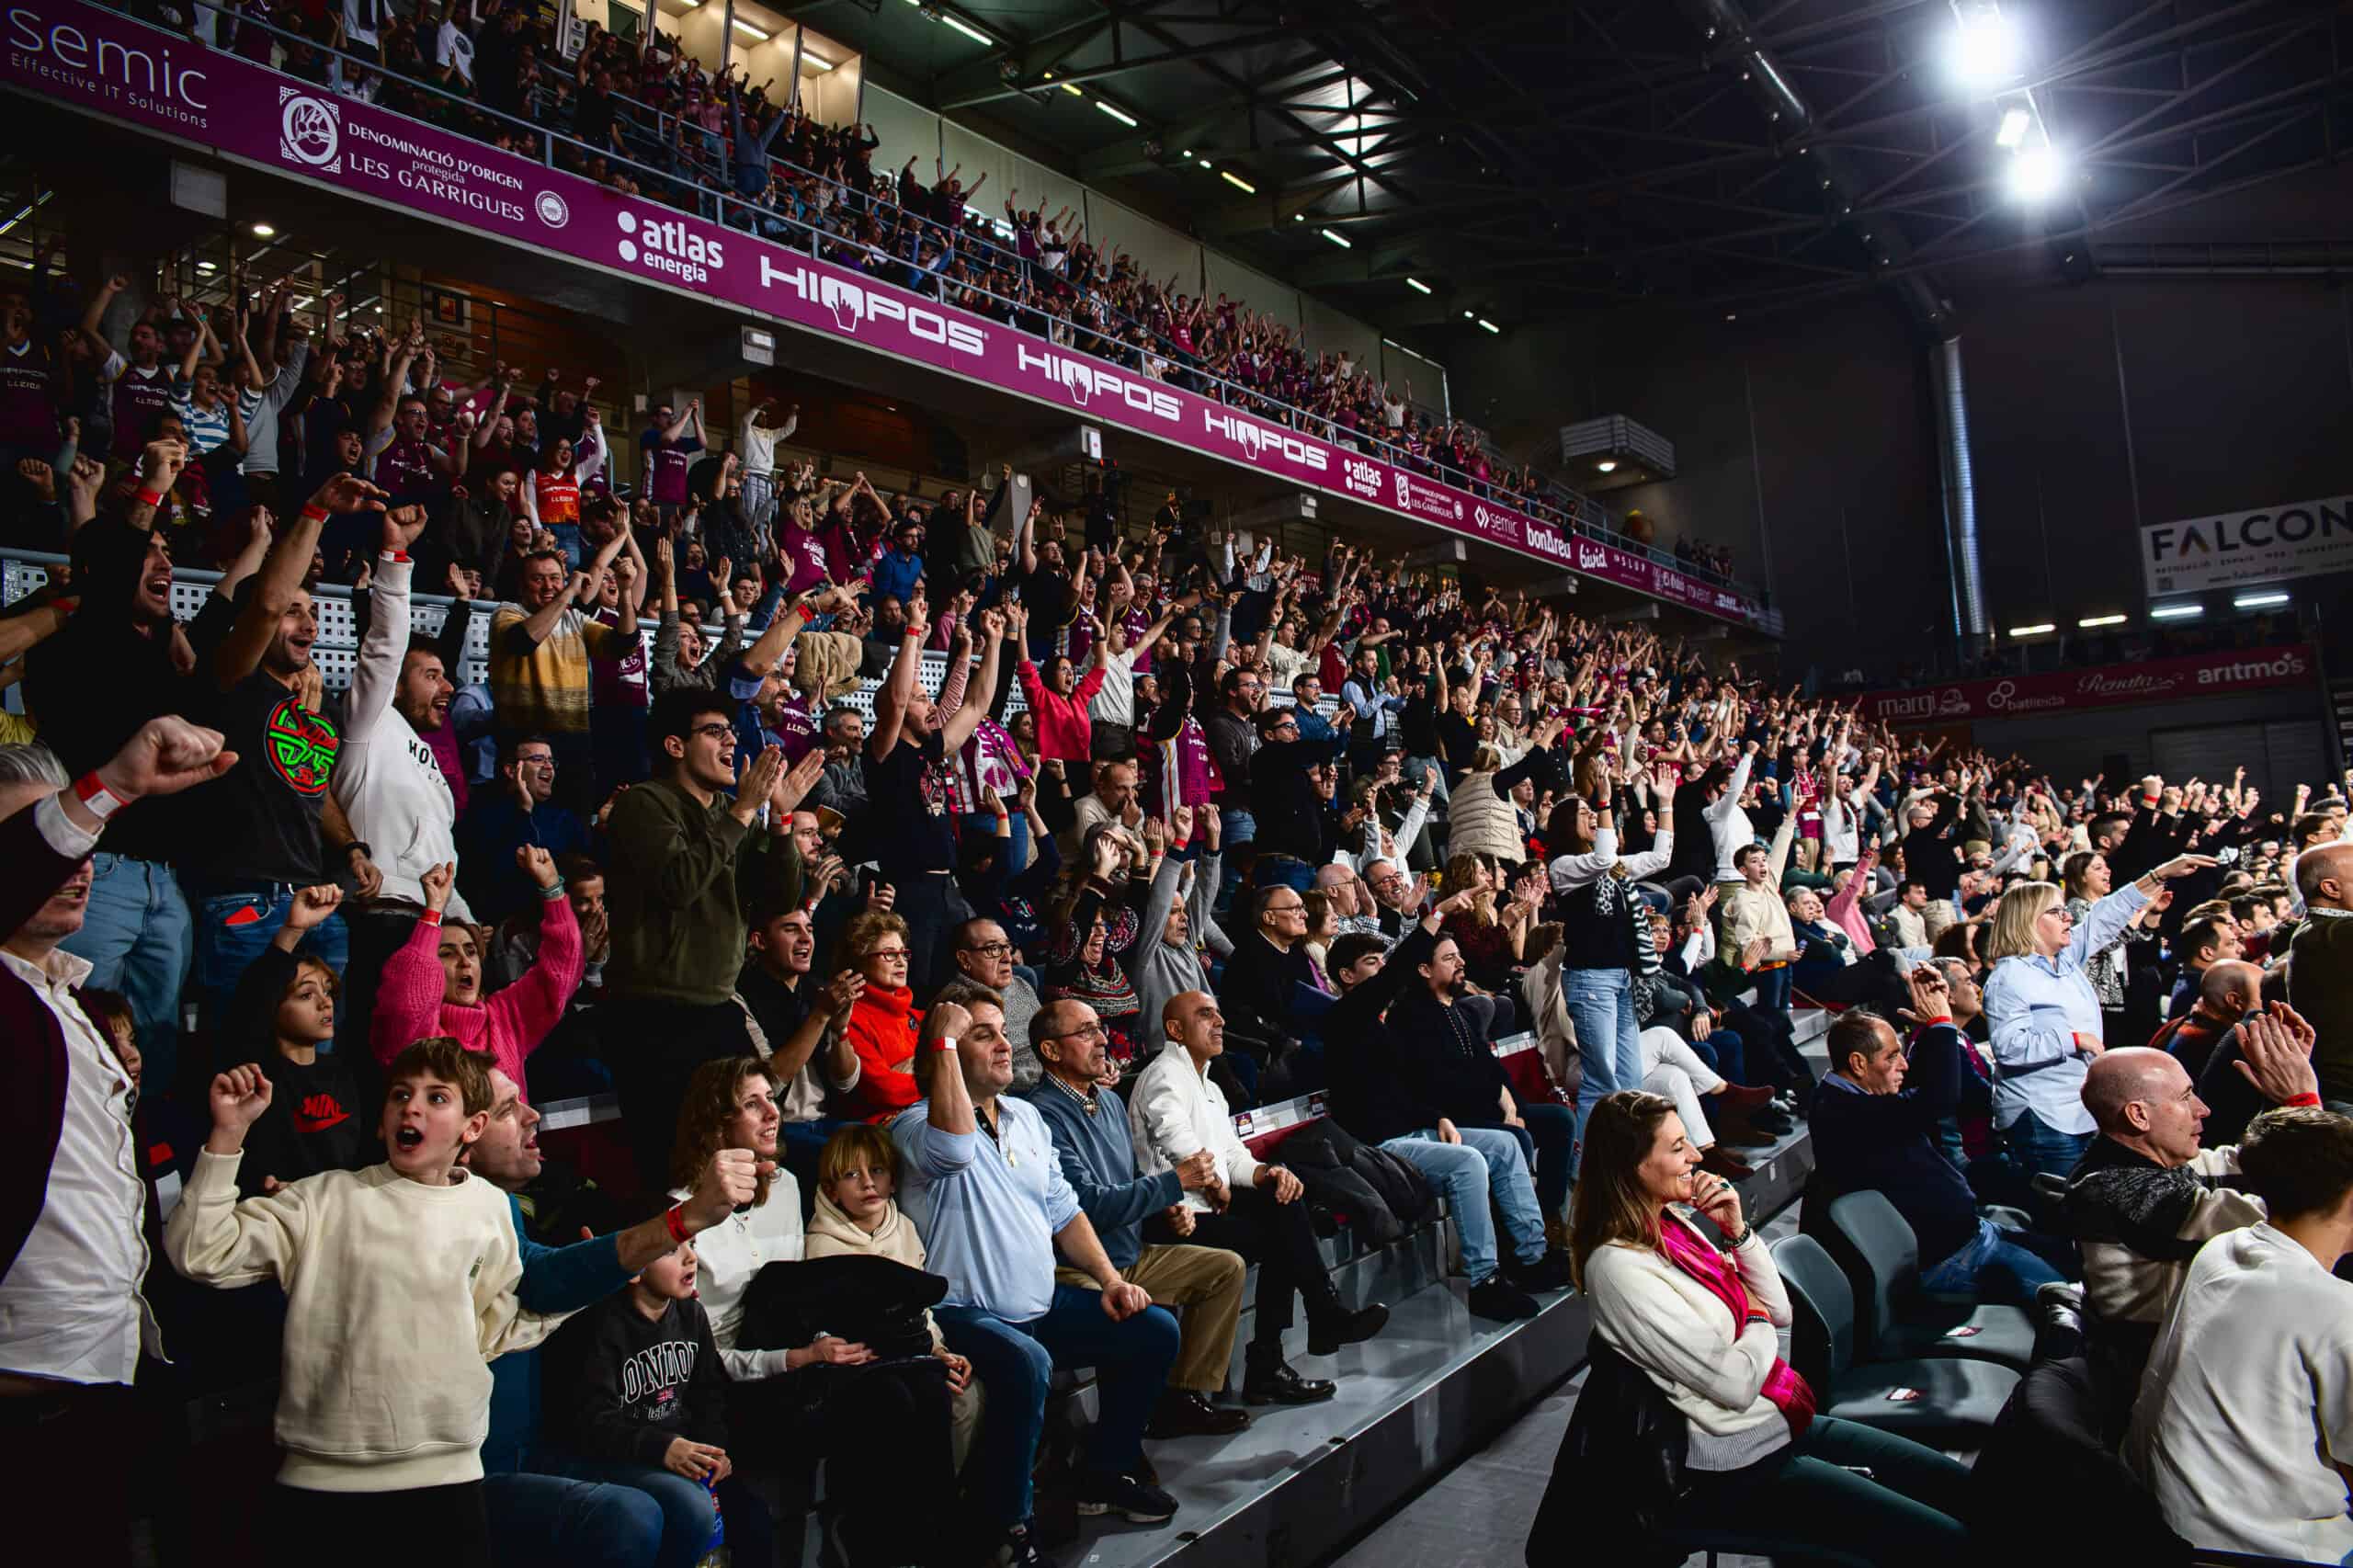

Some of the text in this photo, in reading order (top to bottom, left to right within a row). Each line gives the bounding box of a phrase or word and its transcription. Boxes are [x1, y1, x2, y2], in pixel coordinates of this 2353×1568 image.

[7, 8, 207, 108] semic
[11, 52, 207, 128] Effective IT Solutions
[348, 121, 454, 168] DENOMINACIÓ
[349, 153, 391, 180] LES
[398, 169, 524, 222] GARRIGUES
[412, 160, 465, 185] protegida
[642, 218, 724, 269] atlas
[643, 253, 707, 284] energia
[761, 256, 984, 358] HIOPOS
[1352, 460, 1382, 487] atlas
[1354, 481, 1378, 498] energia
[1489, 513, 1518, 537] semic
[2152, 505, 2353, 561] FALCON
